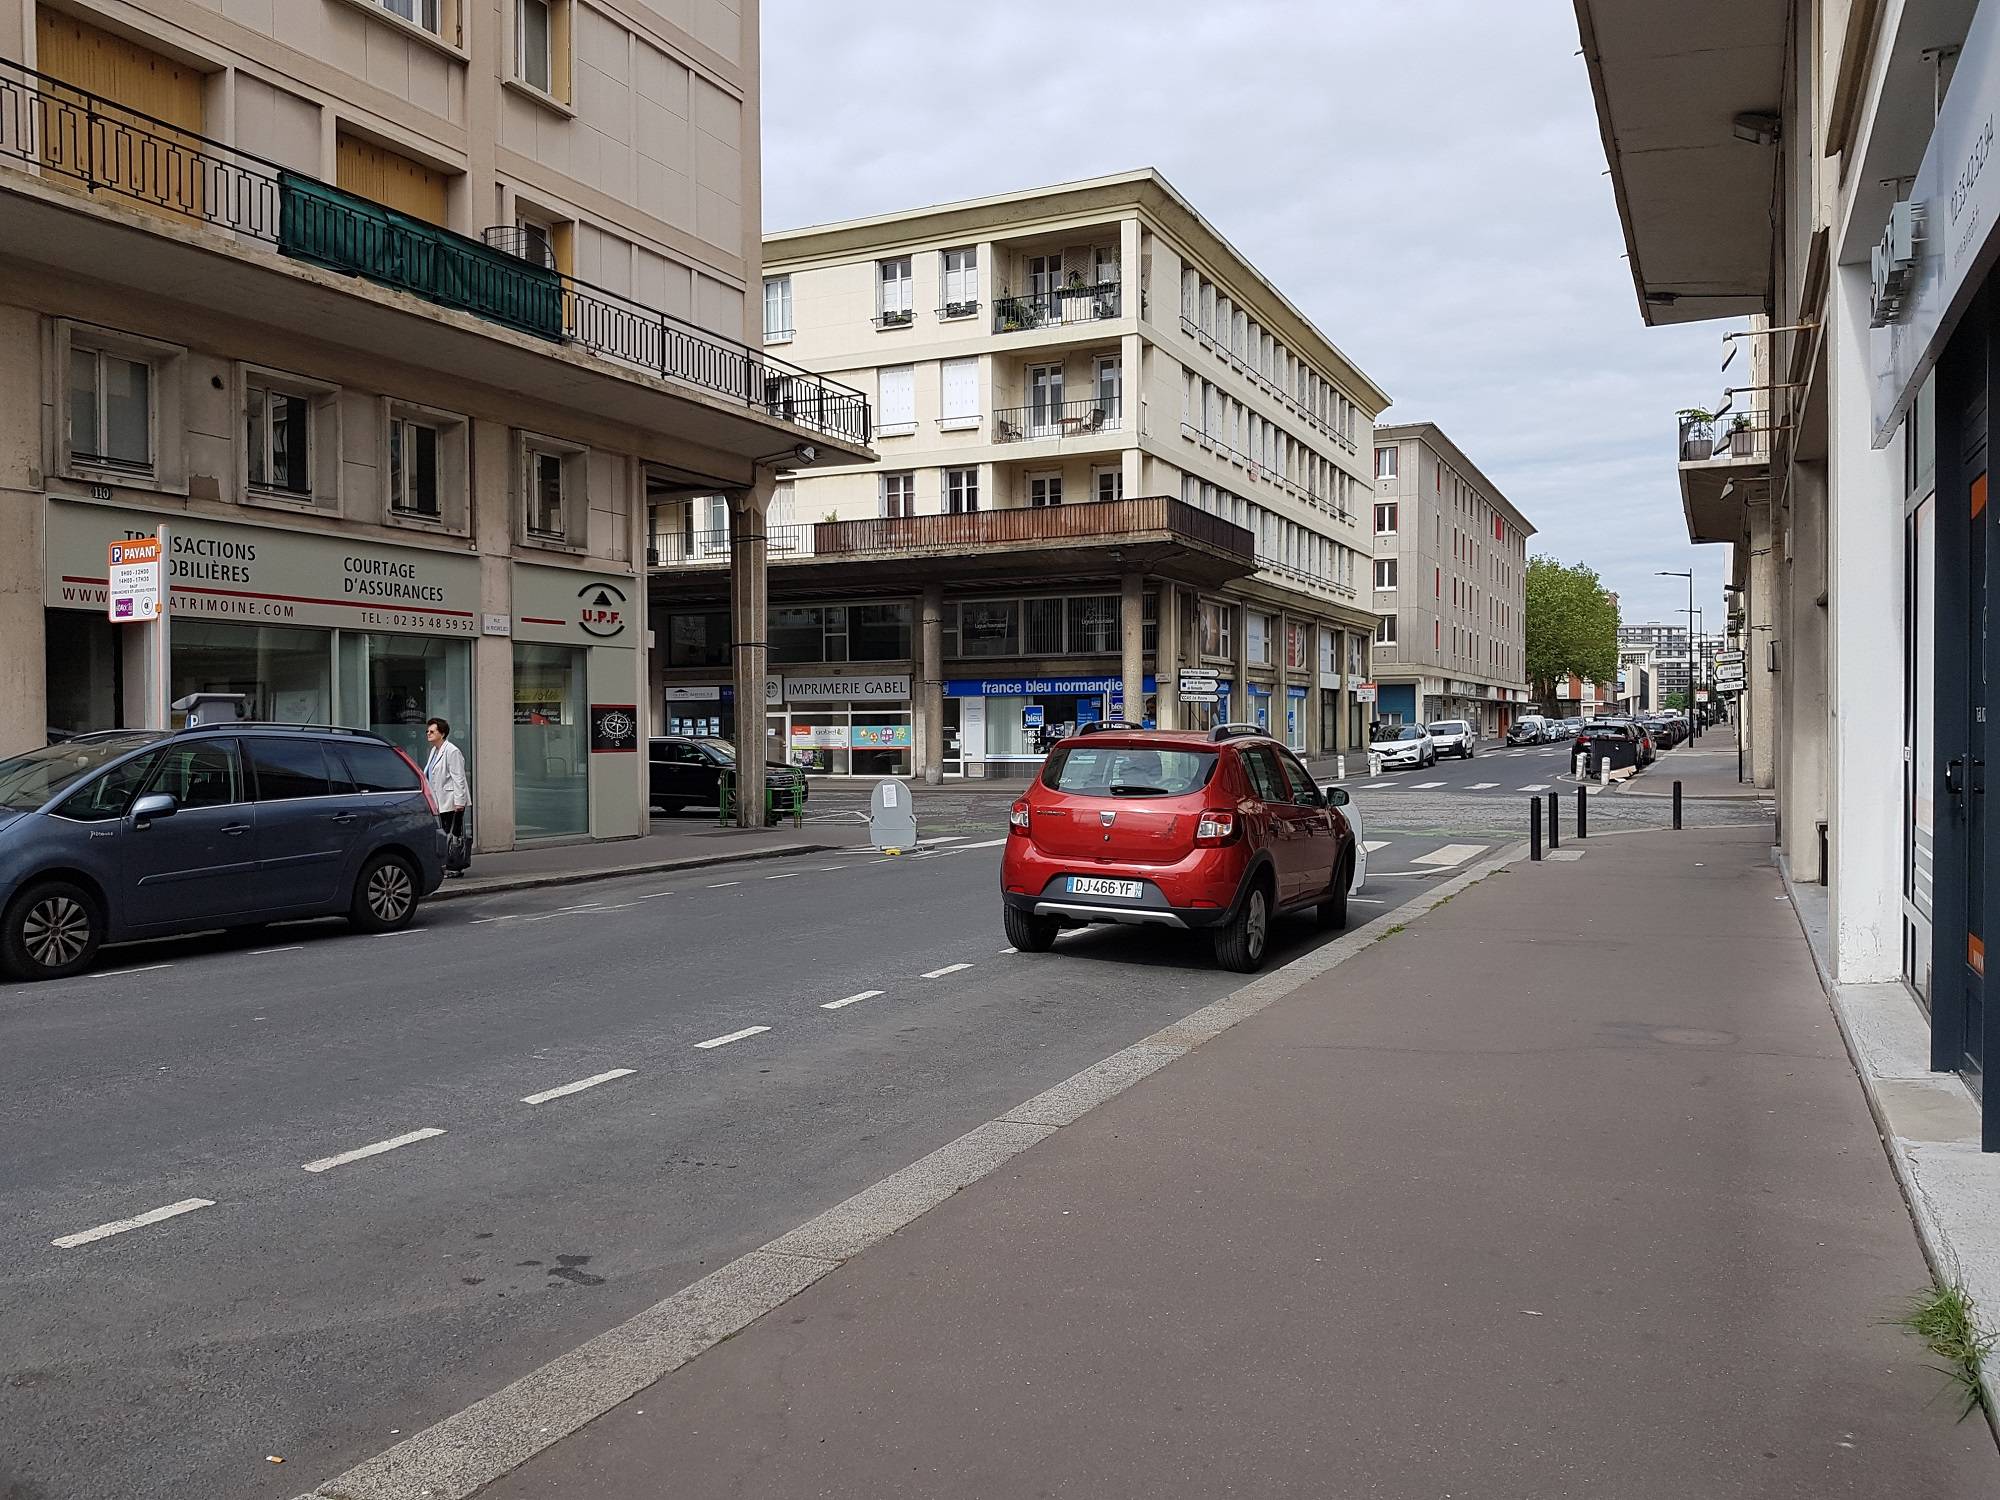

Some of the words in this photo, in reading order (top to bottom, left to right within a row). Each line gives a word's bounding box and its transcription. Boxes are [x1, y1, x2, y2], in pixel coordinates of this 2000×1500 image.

[93, 486, 110, 499] 110
[124, 545, 156, 560] PAYANT
[169, 560, 250, 583] OBILIÈRES
[343, 557, 416, 579] COURTAGE
[344, 577, 444, 602] D'ASSURANCES
[361, 612, 382, 624] TEL
[394, 615, 407, 626] 02
[411, 616, 424, 627] 35
[428, 617, 442, 628] 48
[445, 619, 458, 630] 59
[462, 620, 474, 631] 52
[581, 609, 623, 624] U.P.F.
[788, 681, 861, 696] IMPRIMERIE
[864, 681, 906, 695] GABEL
[981, 681, 1022, 694] france
[1025, 680, 1051, 693] bleu
[1055, 678, 1123, 692] normandie
[1025, 713, 1042, 722] bleu
